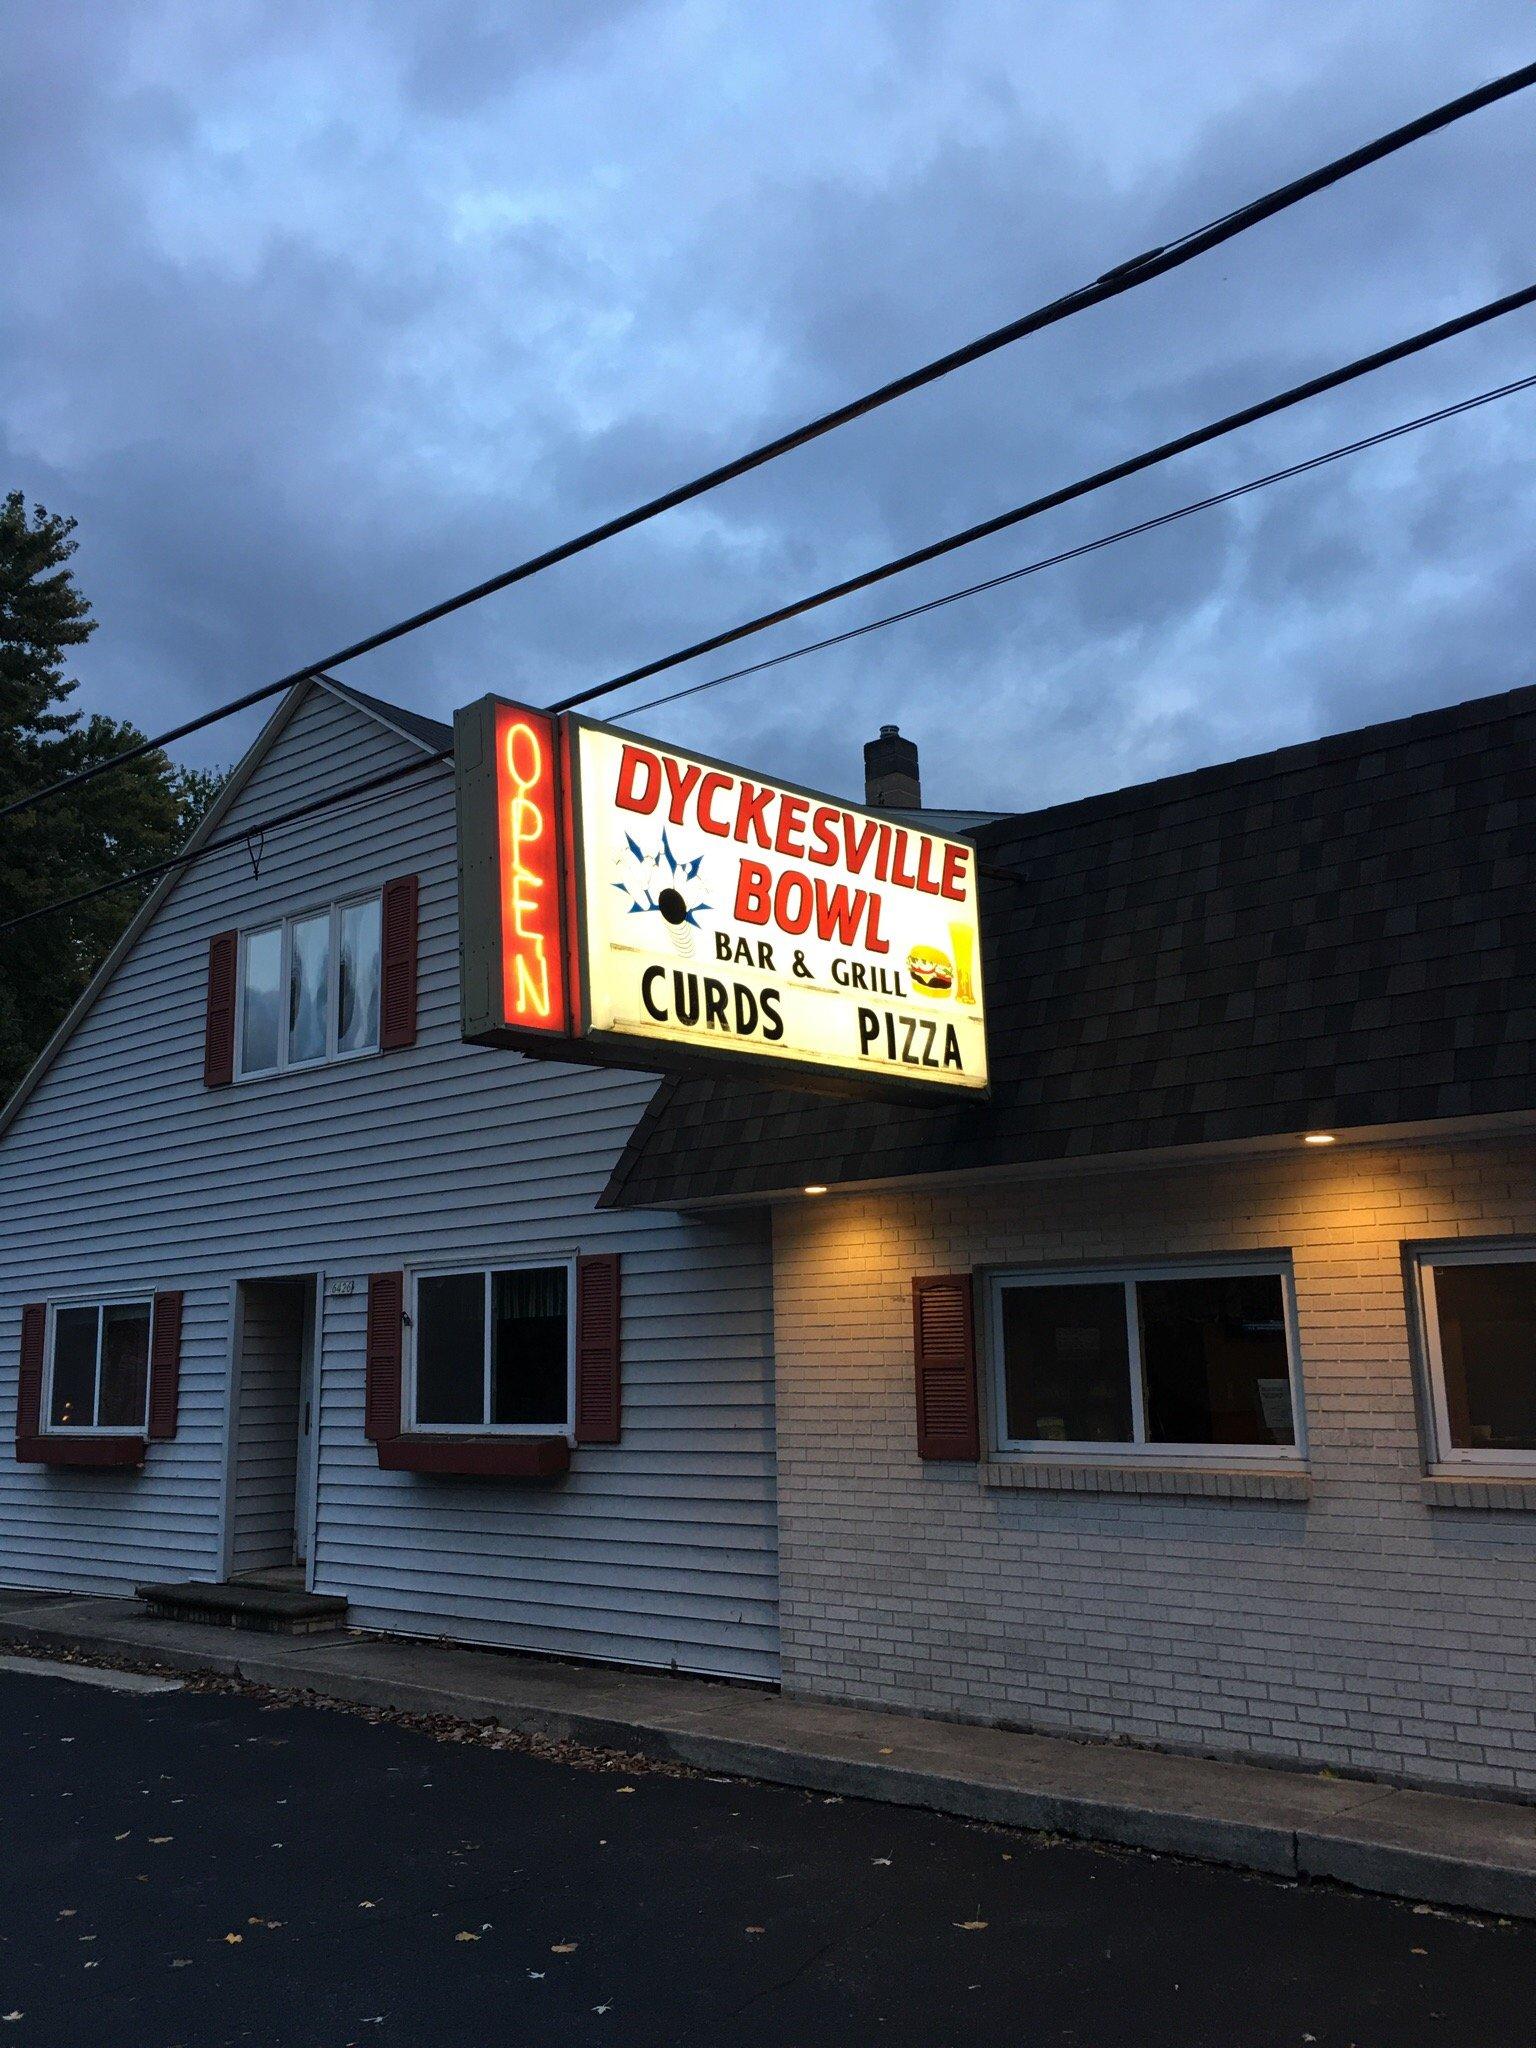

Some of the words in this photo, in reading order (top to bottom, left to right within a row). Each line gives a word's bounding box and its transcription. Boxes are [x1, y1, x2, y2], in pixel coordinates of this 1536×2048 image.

[506, 723, 550, 1017] OPEN
[615, 744, 970, 902] DYCKESVILLE
[734, 857, 890, 954] BOWL
[714, 931, 777, 972] BAR
[792, 949, 815, 979] &
[831, 958, 908, 998] GRILL
[641, 965, 784, 1041] CURDS
[857, 1007, 963, 1071] PIZZA
